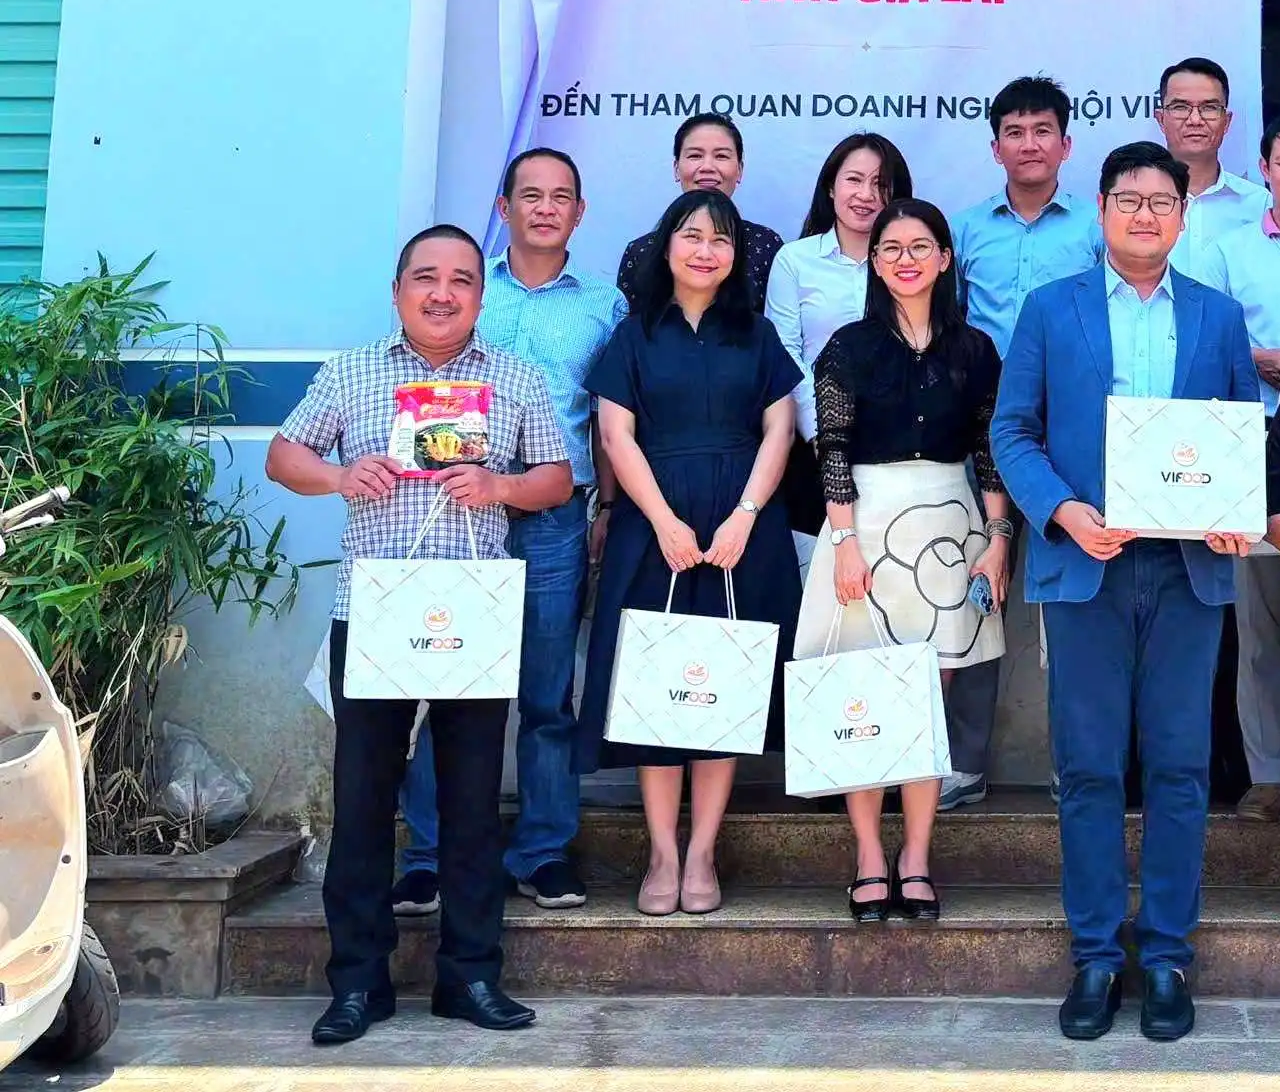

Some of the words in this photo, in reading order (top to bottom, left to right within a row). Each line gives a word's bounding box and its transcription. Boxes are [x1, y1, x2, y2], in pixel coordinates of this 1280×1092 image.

[540, 82, 600, 117] ĐẾN
[611, 93, 702, 116] THAM
[710, 93, 801, 118] QUAN
[811, 94, 926, 118] DOANH
[1161, 471, 1211, 484] VIFOOD
[409, 637, 464, 649] VIFOOD
[669, 689, 717, 704] VIFOOD
[833, 724, 881, 740] VIFOOD
